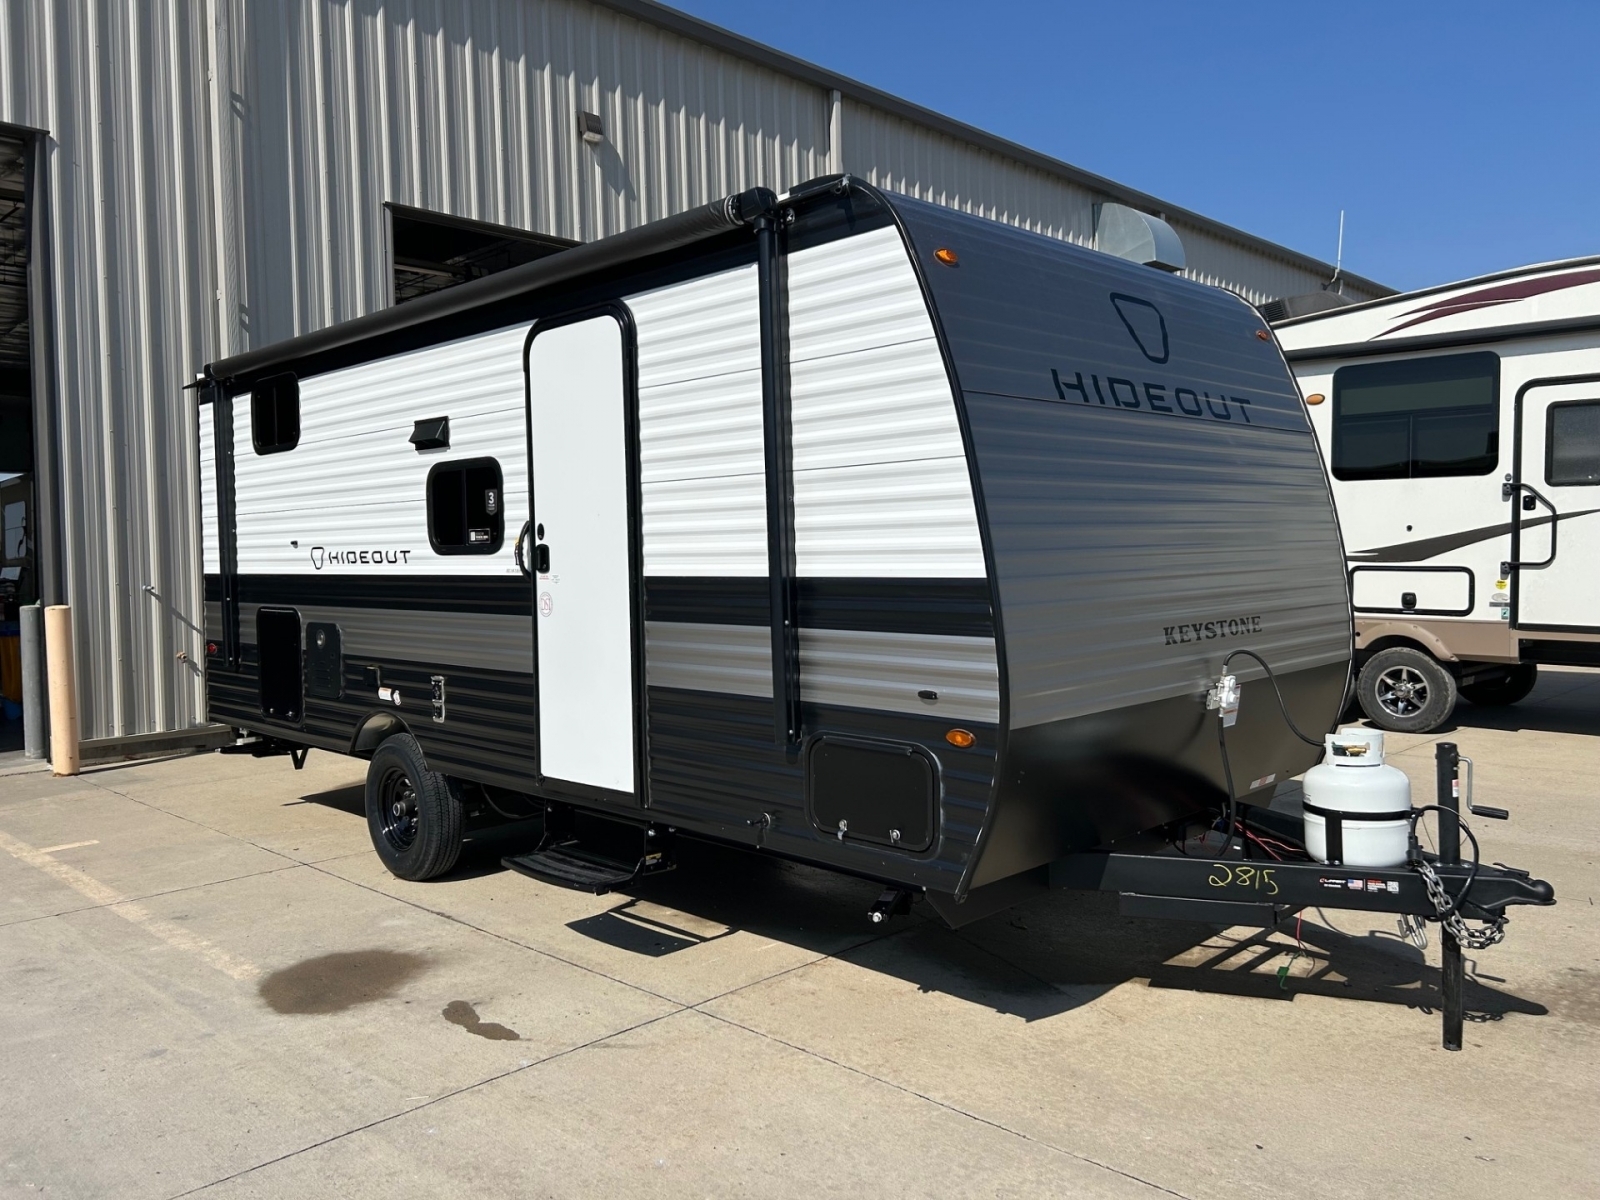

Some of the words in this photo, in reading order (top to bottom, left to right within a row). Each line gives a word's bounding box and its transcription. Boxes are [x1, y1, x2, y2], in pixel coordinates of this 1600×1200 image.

[1051, 368, 1251, 423] HIDEOUT
[488, 491, 495, 504] 3
[328, 550, 411, 564] HIDEOUT
[1163, 616, 1262, 645] KEYSTONE
[1208, 864, 1279, 895] 2815
